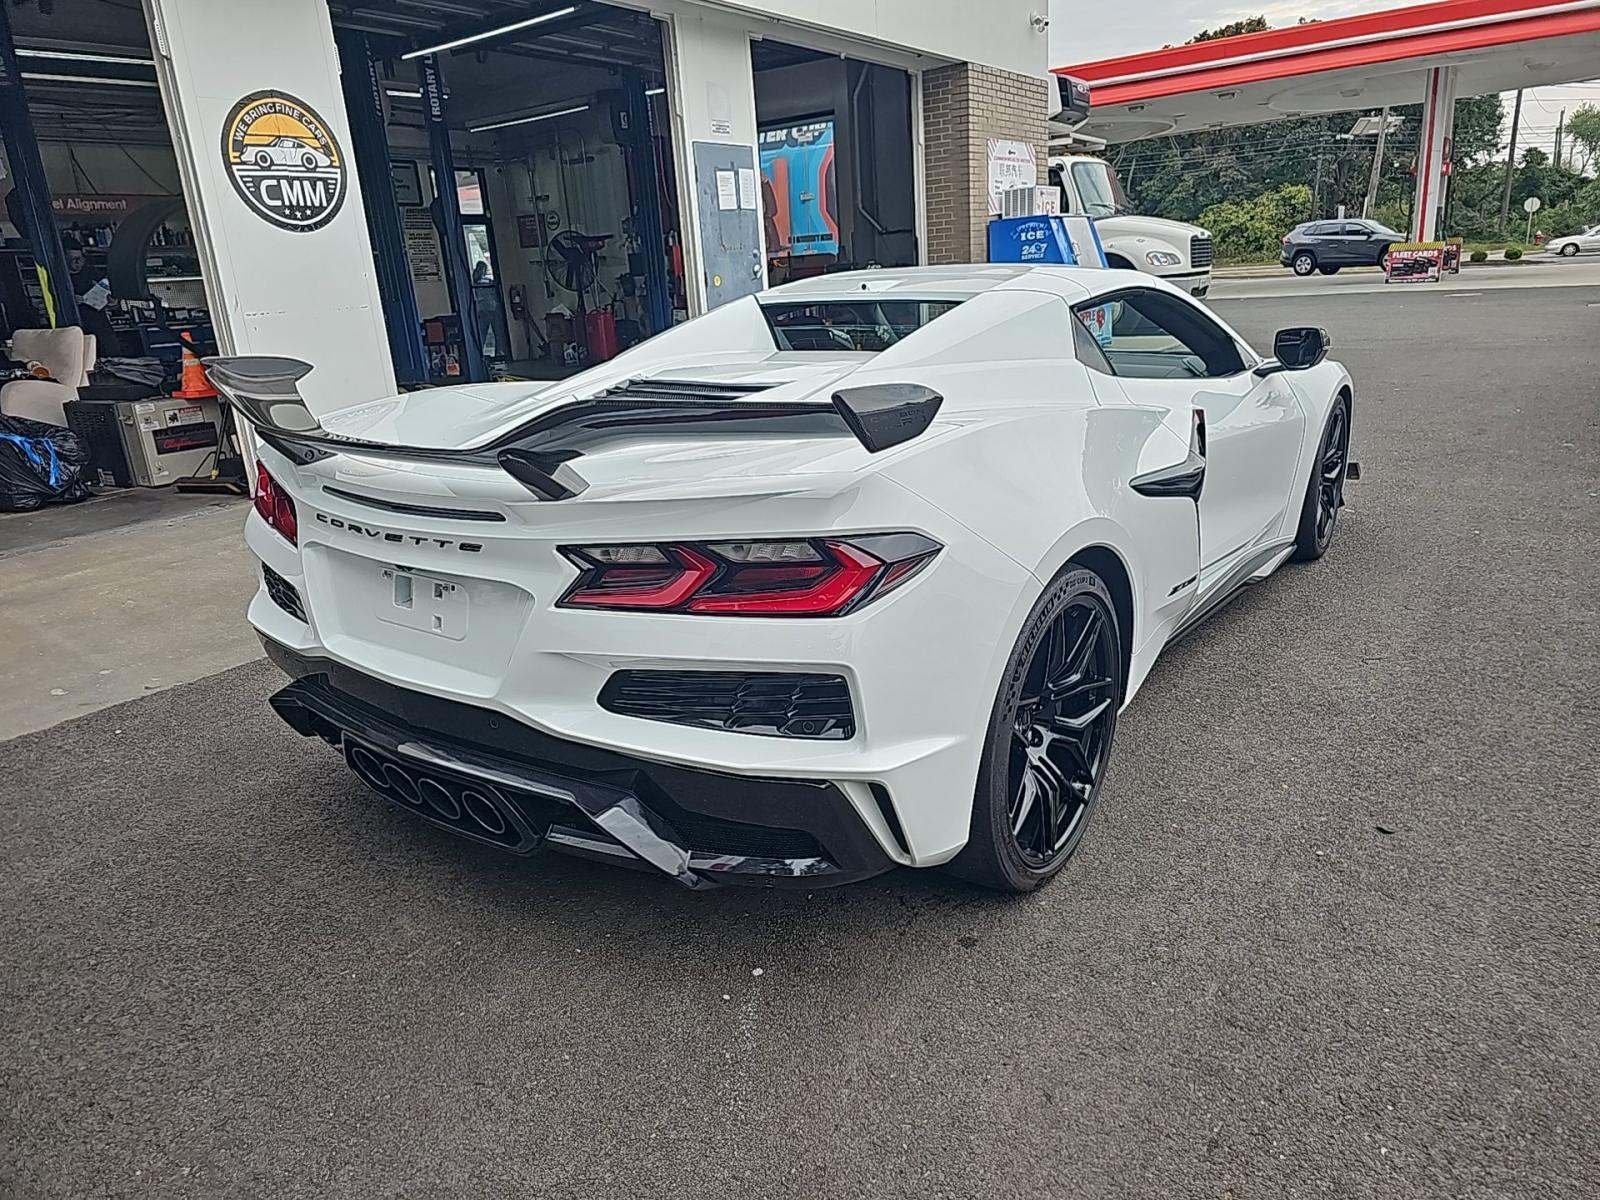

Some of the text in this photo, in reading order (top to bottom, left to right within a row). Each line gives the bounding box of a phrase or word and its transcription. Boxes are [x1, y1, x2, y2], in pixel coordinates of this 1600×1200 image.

[425, 67, 442, 115] ROTARY
[234, 103, 327, 146] WE BRING FINE CARS
[67, 198, 127, 212] Alignment
[260, 178, 327, 207] CMM
[1041, 200, 1056, 214] ICE
[1020, 230, 1045, 241] ICE
[1392, 250, 1439, 259] FLEET CARDS
[316, 512, 483, 553] CORVETTE
[1021, 598, 1055, 662] MICHELIN
